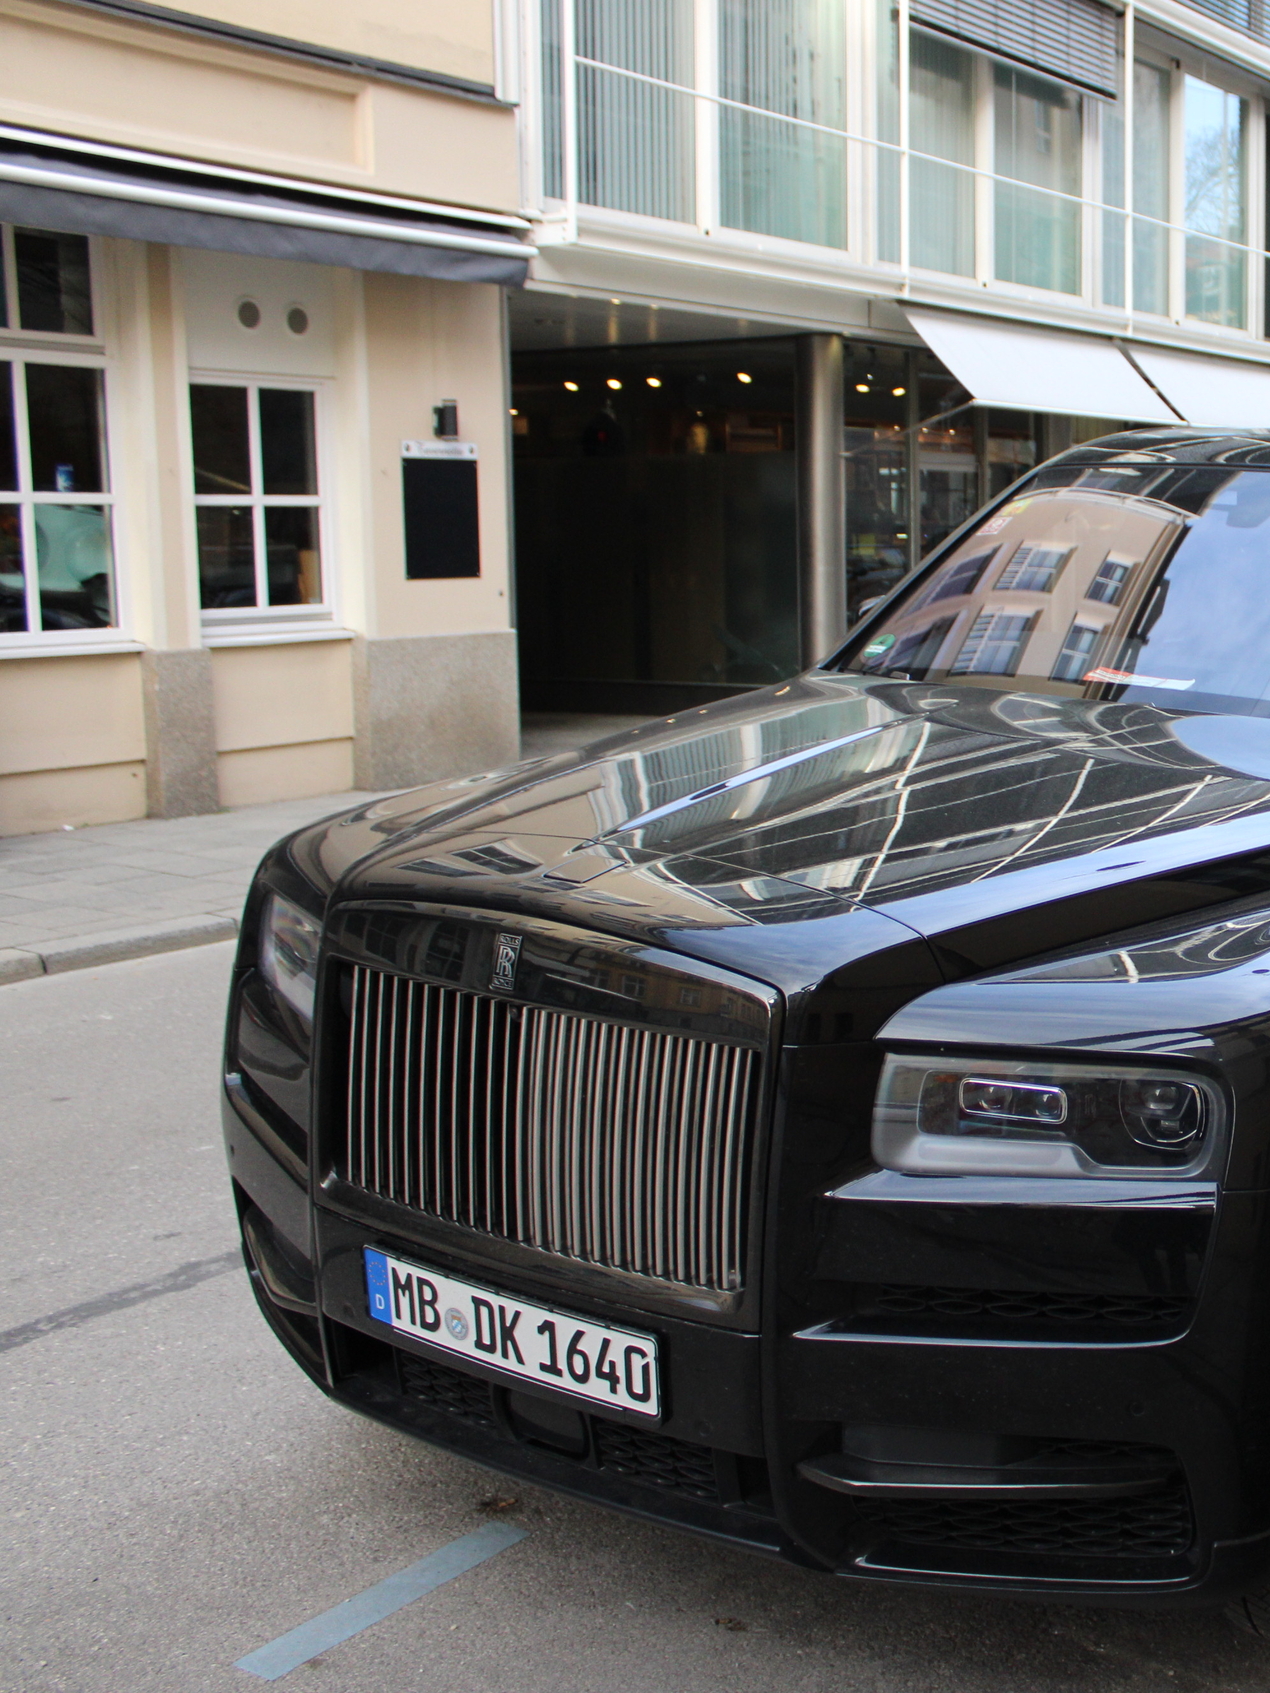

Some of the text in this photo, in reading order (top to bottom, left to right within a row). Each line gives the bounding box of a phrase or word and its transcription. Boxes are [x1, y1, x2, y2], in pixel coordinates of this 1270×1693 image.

[375, 1293, 385, 1310] D
[391, 1266, 441, 1333] MB
[472, 1295, 525, 1366] DK
[538, 1319, 652, 1404] 1640
